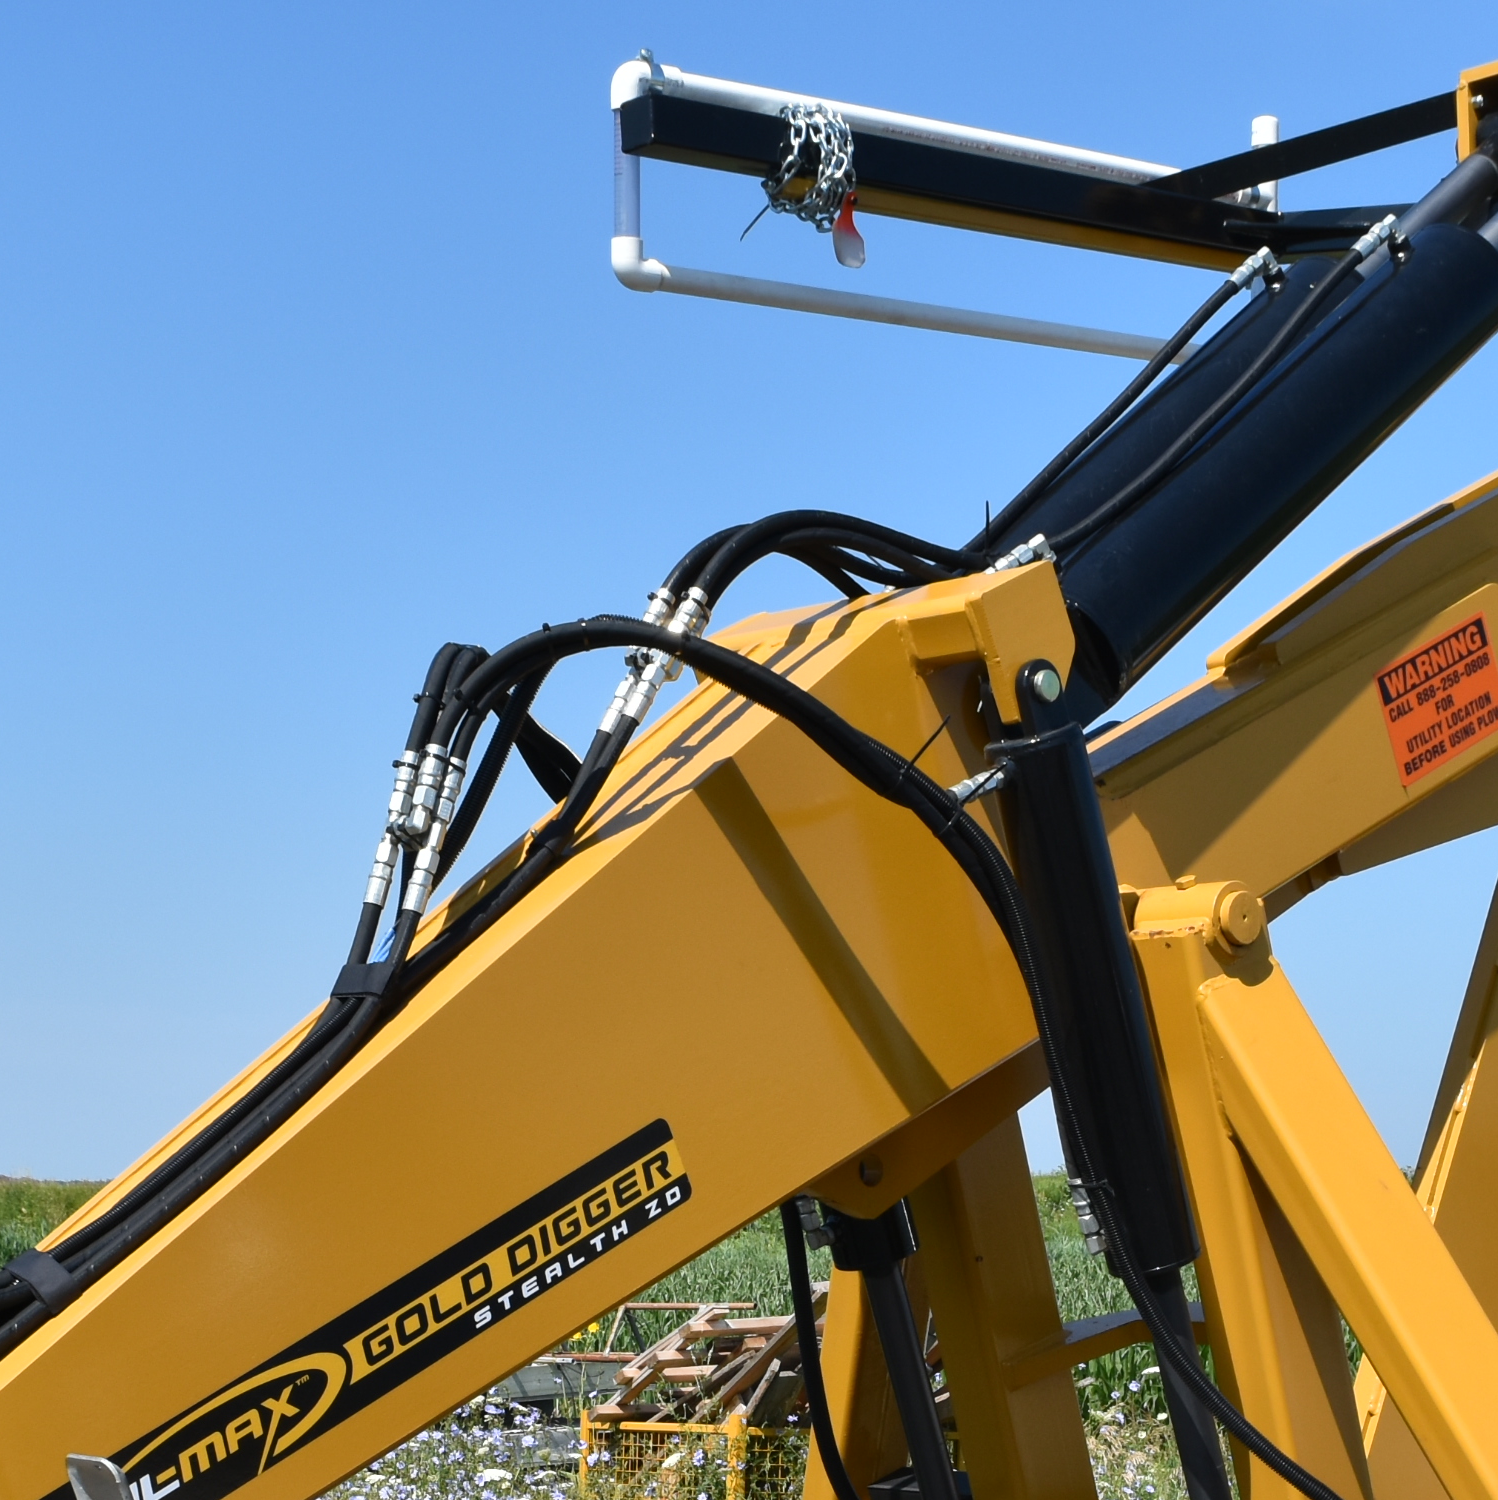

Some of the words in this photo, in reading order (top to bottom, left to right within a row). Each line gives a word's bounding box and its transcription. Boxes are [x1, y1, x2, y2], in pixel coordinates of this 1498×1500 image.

[1383, 624, 1483, 699] WARNING
[1388, 700, 1414, 723] CALL
[1416, 652, 1491, 707] 888-258-0808
[1406, 723, 1444, 754] UTILITY
[1446, 691, 1492, 733] LOCATION
[1434, 694, 1455, 716] FOR
[1403, 740, 1448, 776] BEFORE
[1449, 721, 1476, 749] USING
[361, 1262, 494, 1367] GOLD
[506, 1150, 673, 1277] DIGGER
[473, 1219, 631, 1329] STEALTH
